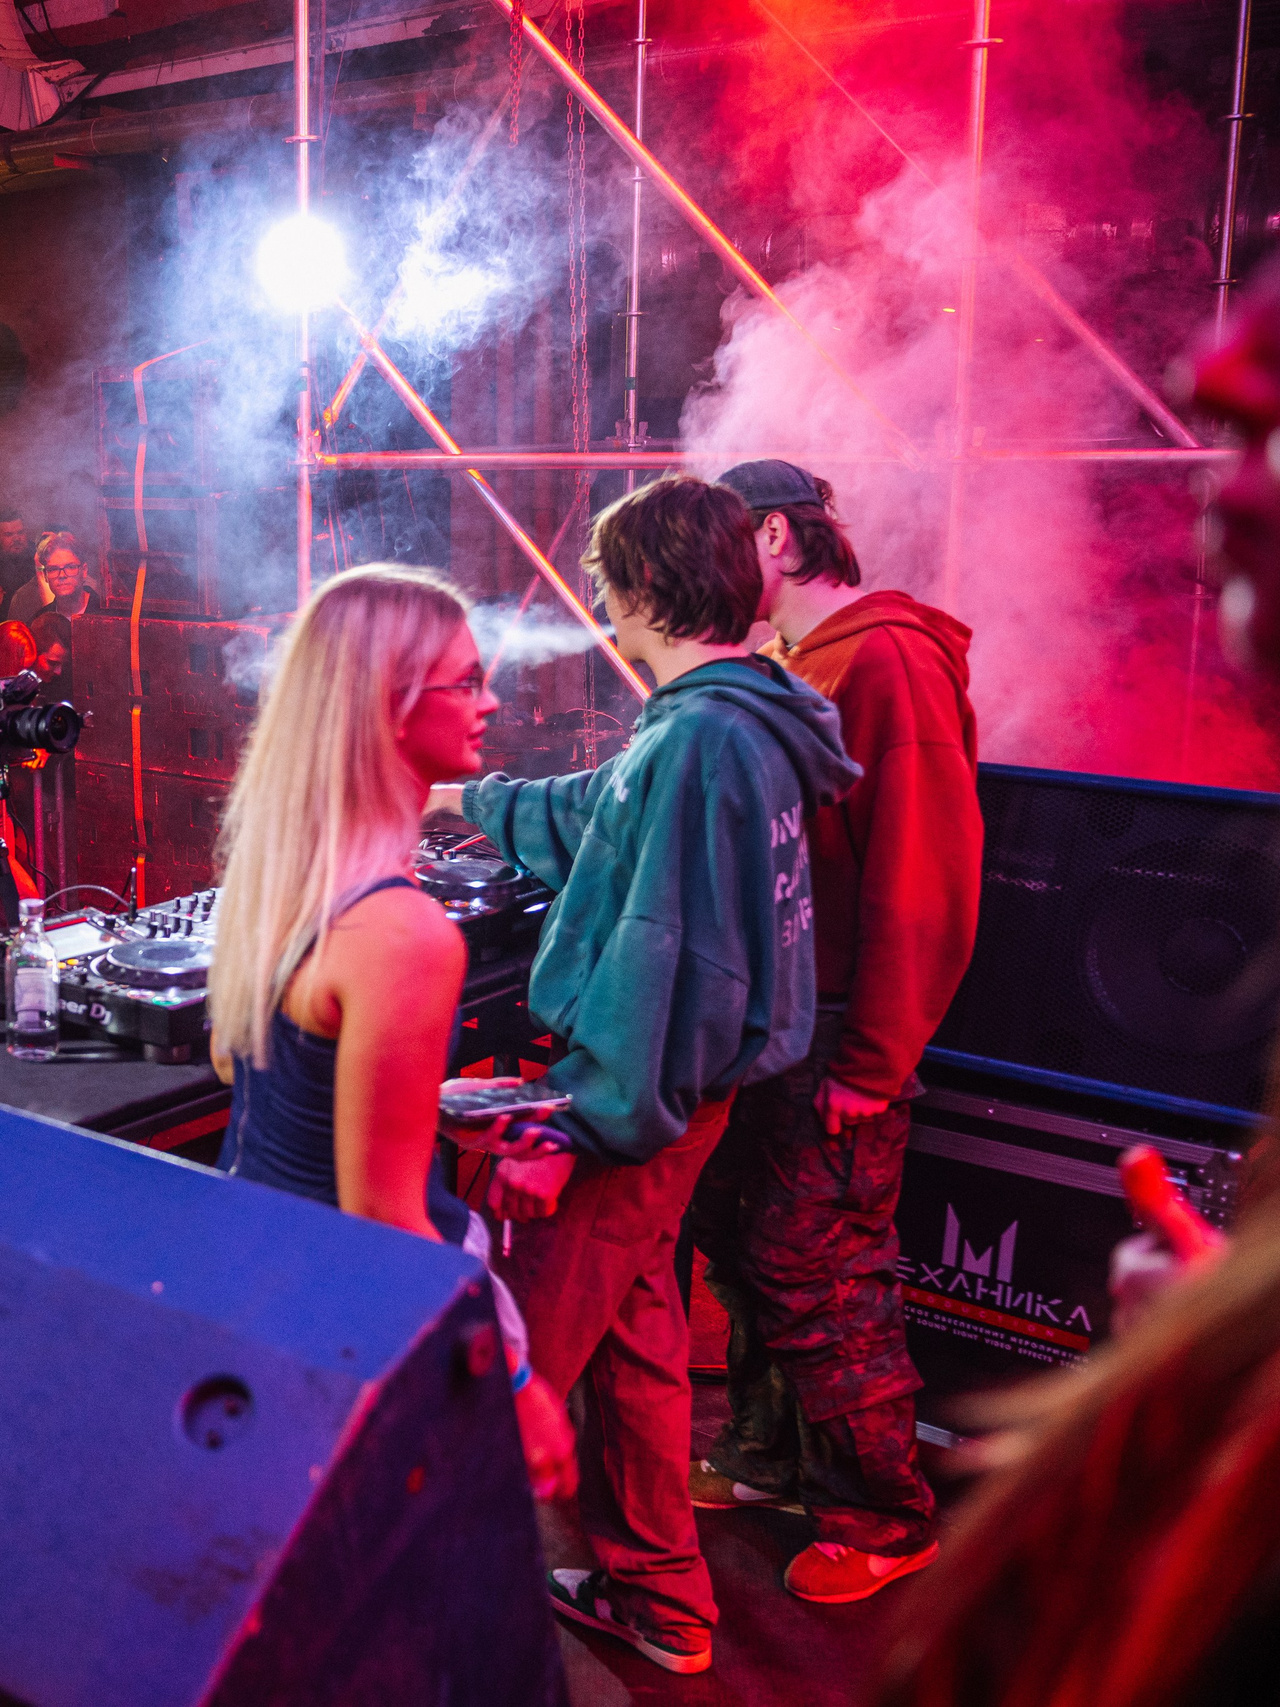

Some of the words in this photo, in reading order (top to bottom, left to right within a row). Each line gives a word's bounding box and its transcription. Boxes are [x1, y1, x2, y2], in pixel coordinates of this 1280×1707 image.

[895, 1255, 1092, 1332] ЕХАНИКА
[909, 1289, 1055, 1338] RODUCTION
[916, 1317, 948, 1332] SOUND
[952, 1327, 979, 1341] LIGHT
[984, 1337, 1012, 1352] VIDEO
[1017, 1346, 1054, 1364] EFFECTS
